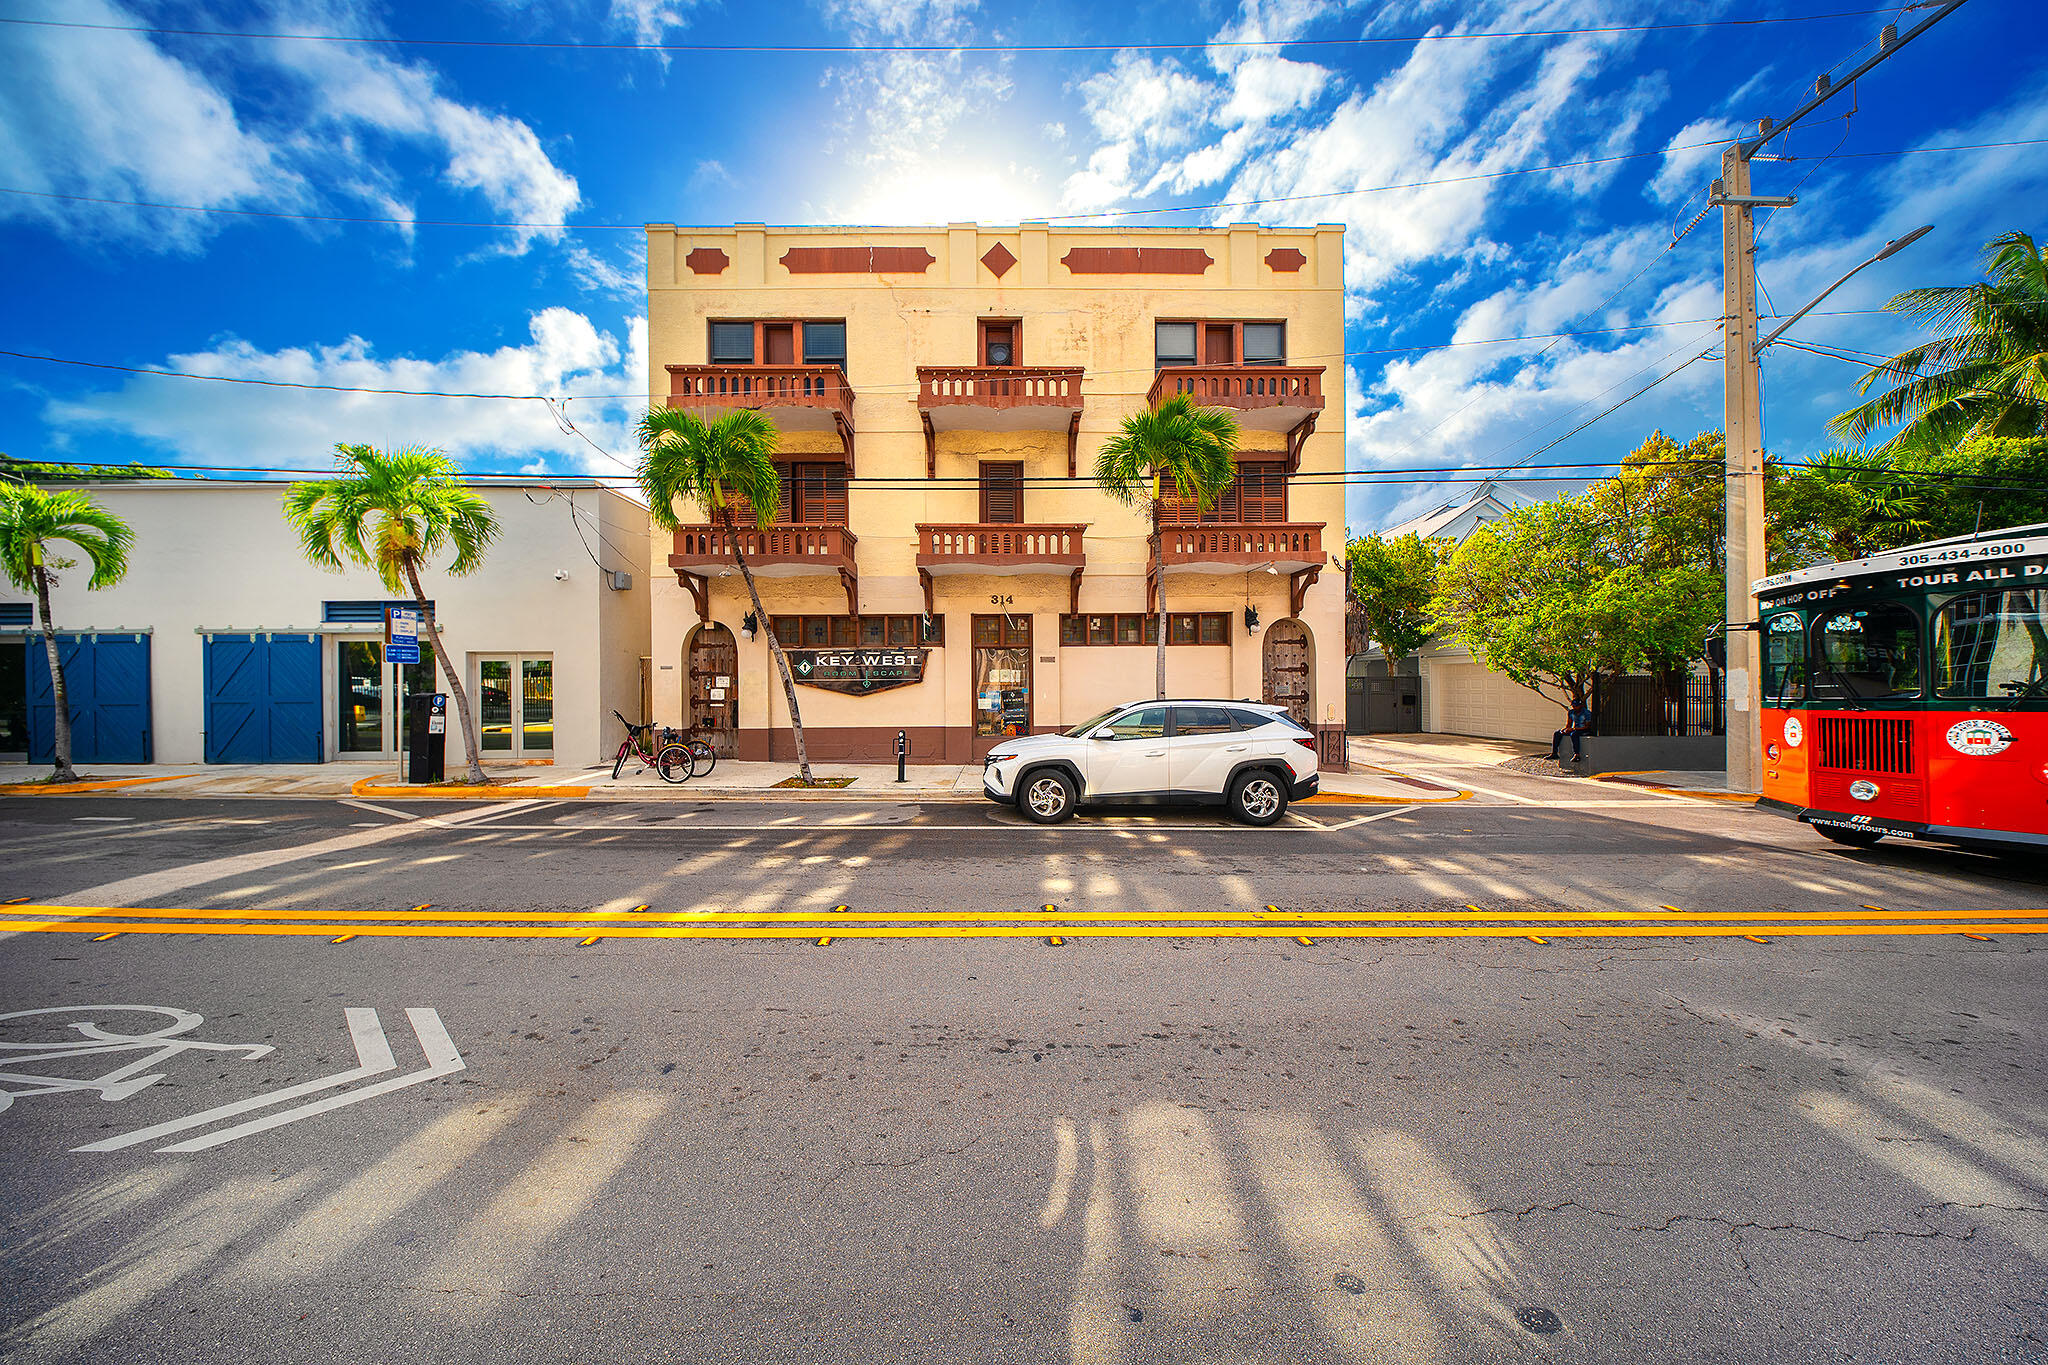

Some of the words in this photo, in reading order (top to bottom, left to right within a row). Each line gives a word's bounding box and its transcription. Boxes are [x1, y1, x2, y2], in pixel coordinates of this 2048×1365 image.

[1898, 543, 2026, 566] 305-434-4900
[1775, 597, 1787, 607] ON
[1787, 593, 1804, 604] HOP
[1807, 589, 1838, 600] OFF
[1897, 573, 1959, 588] TOUR
[1965, 567, 2017, 582] ALL
[991, 595, 1014, 605] 314
[394, 610, 401, 618] P
[816, 656, 854, 666] KEY
[862, 656, 918, 666] WEST
[437, 697, 443, 705] P
[1850, 814, 1873, 825] 612
[1808, 817, 1915, 839] www.trolleytours.com
